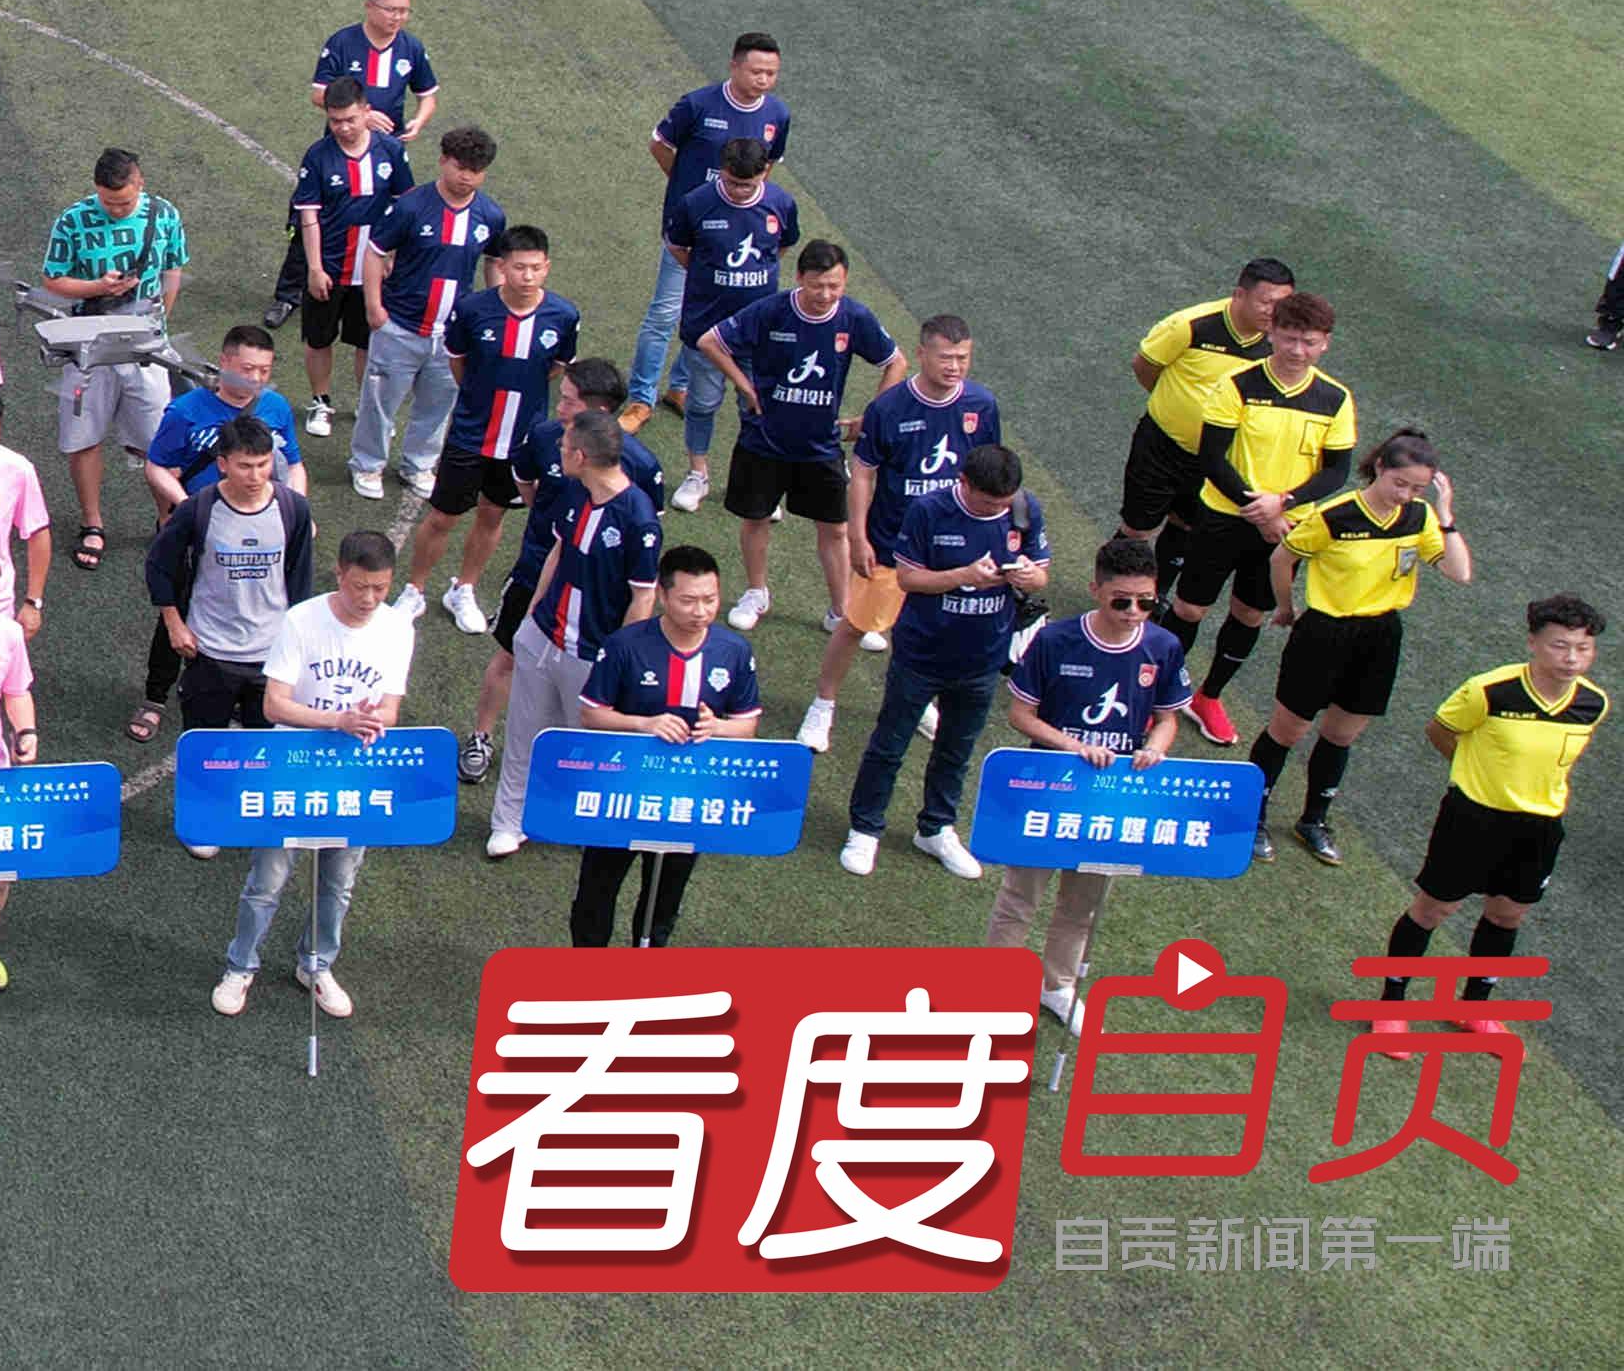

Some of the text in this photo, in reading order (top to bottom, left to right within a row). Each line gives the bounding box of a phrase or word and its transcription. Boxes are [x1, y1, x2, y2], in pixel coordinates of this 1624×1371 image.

[308, 657, 384, 689] TOMMY
[240, 790, 395, 818] 自贡市燃气
[574, 790, 757, 826] 四川远建设计
[1023, 810, 1212, 847] 自贡市媒体联
